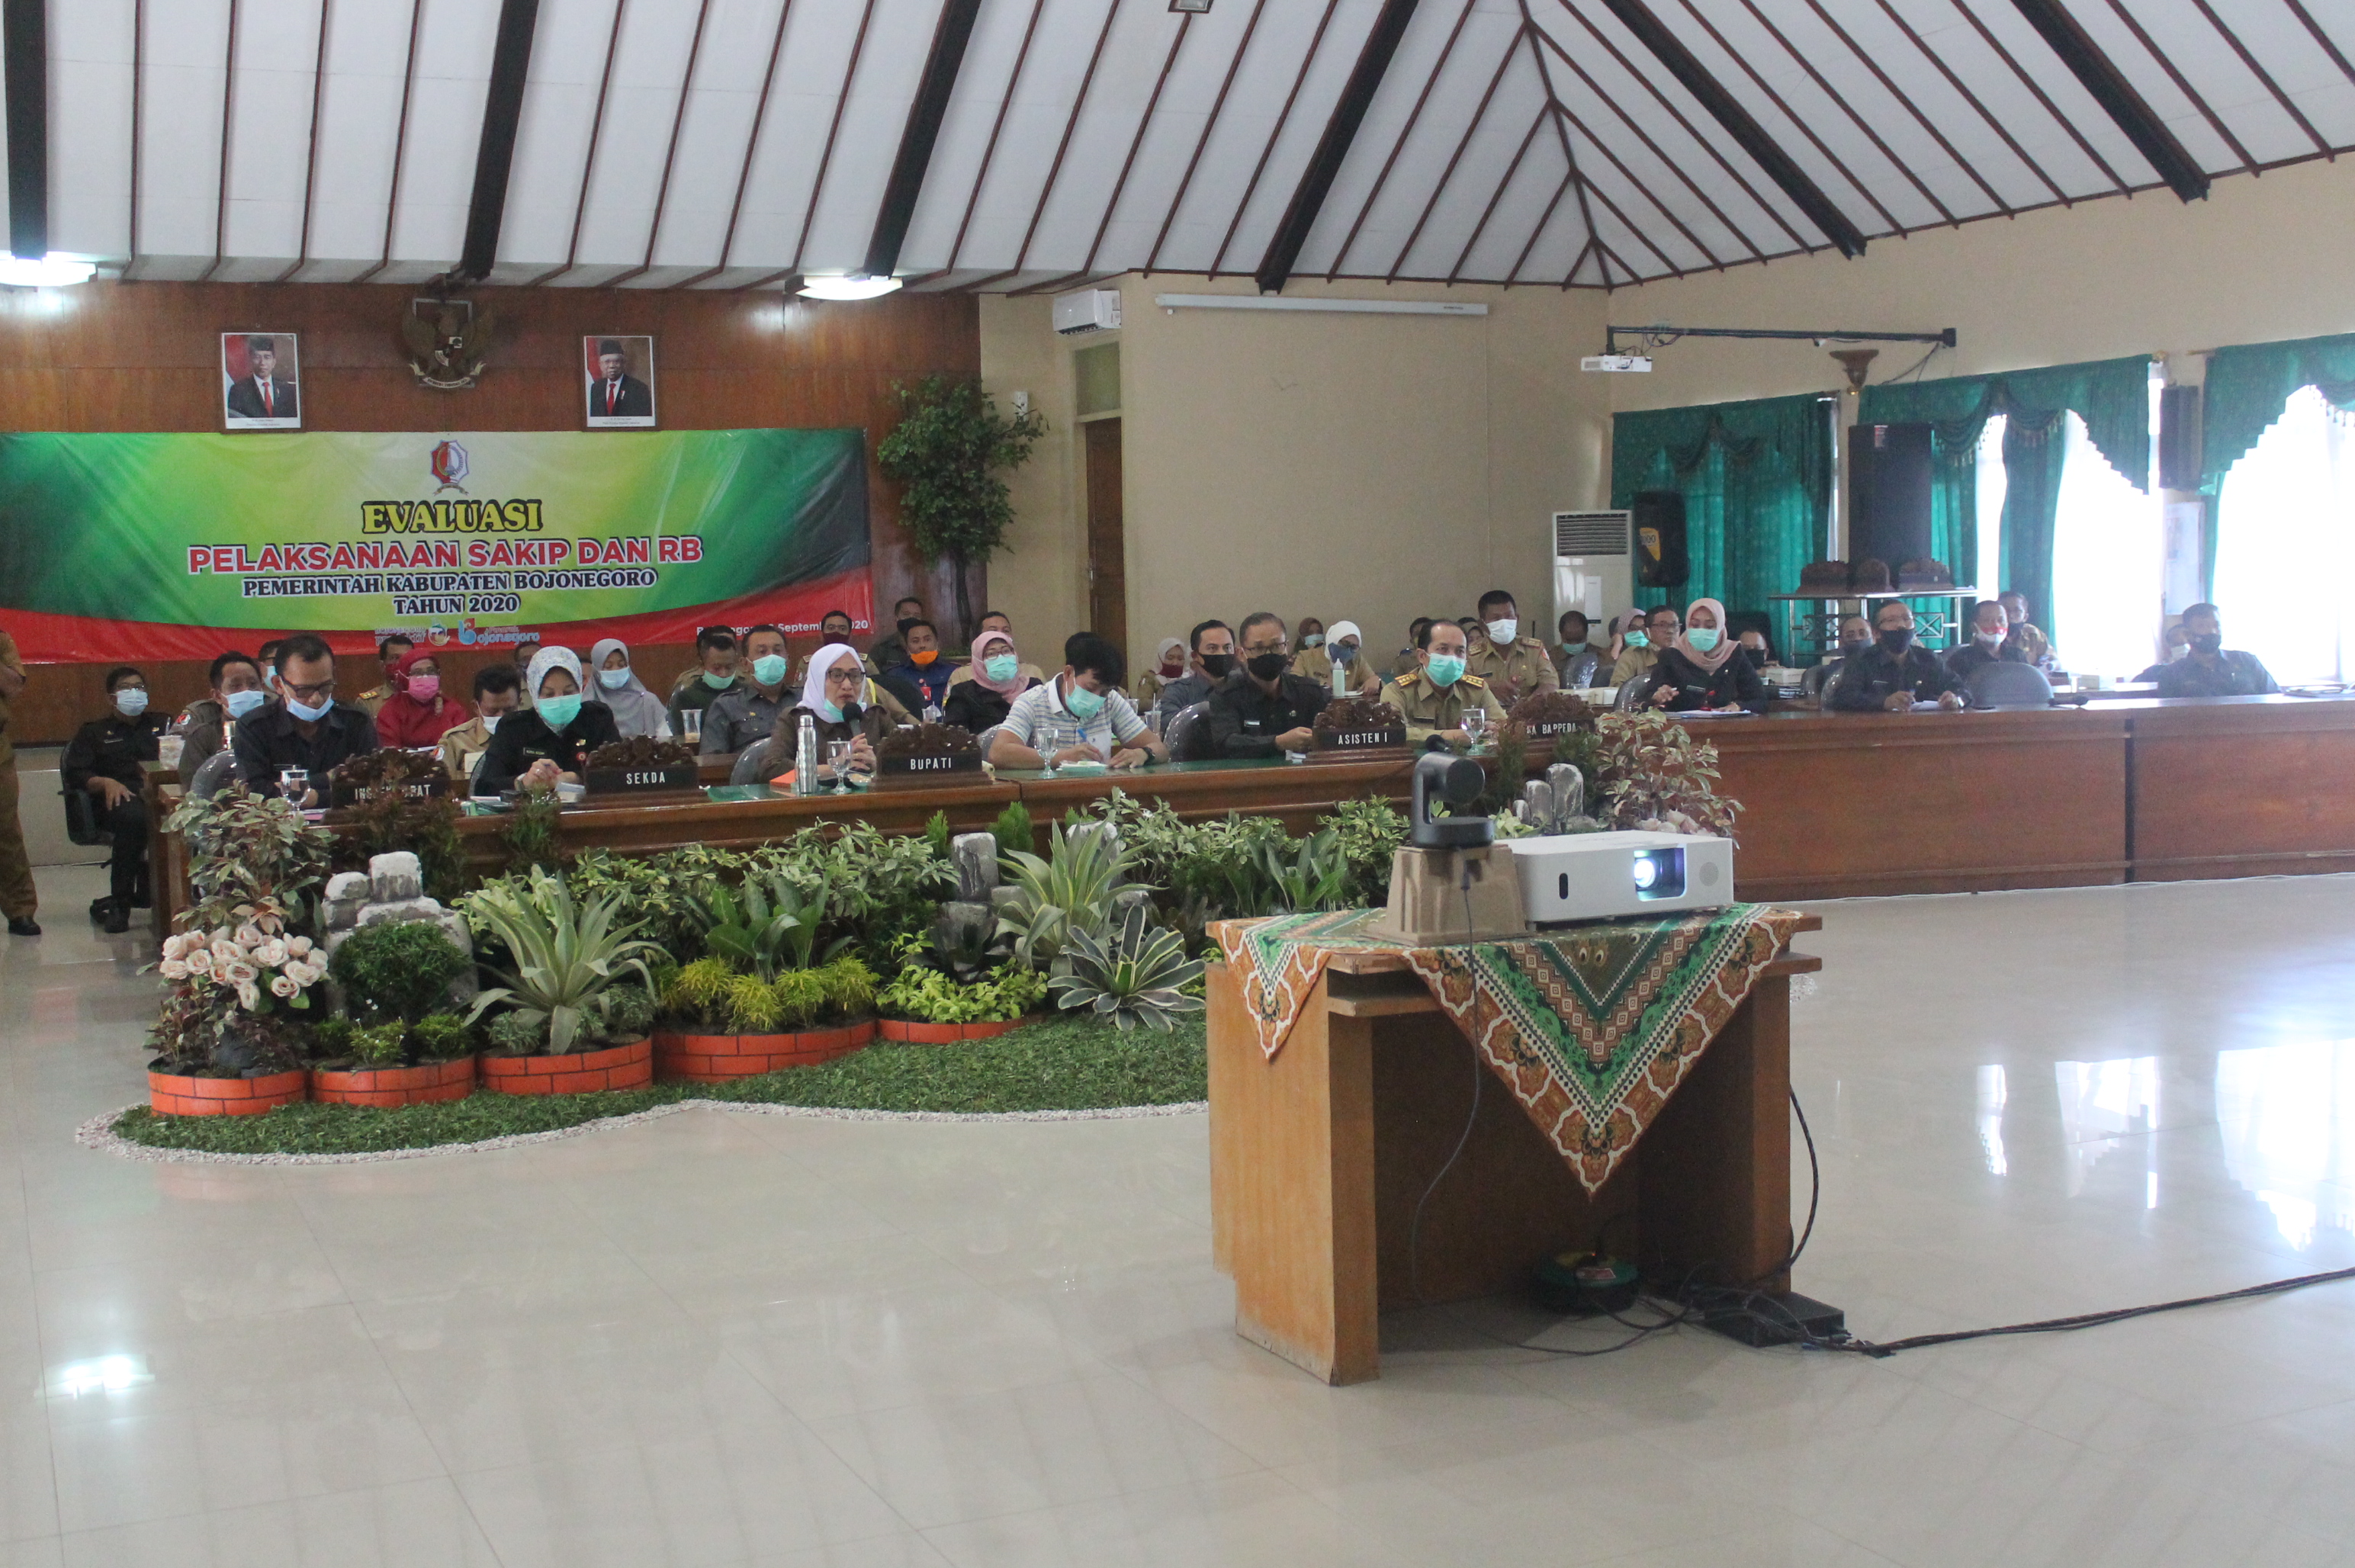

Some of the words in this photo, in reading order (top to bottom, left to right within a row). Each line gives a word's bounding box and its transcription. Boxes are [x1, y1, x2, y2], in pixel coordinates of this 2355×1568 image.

[361, 498, 543, 534] EVALUASI
[188, 541, 461, 574] PELAKSANAAN
[467, 538, 571, 568] SAKIP
[577, 535, 651, 566] DAN
[657, 535, 703, 564] RB
[243, 574, 384, 597] PEMERINTAH
[386, 570, 510, 594] KABUPATEN
[513, 567, 658, 590] BOJONEGORO
[393, 594, 465, 615] TAHUN
[467, 592, 521, 612] 2020
[778, 622, 822, 633] Septem
[1338, 732, 1380, 745] ASISTEN
[1384, 731, 1387, 743] I
[910, 757, 952, 770] BUPATI
[626, 771, 666, 785] SEKDA
